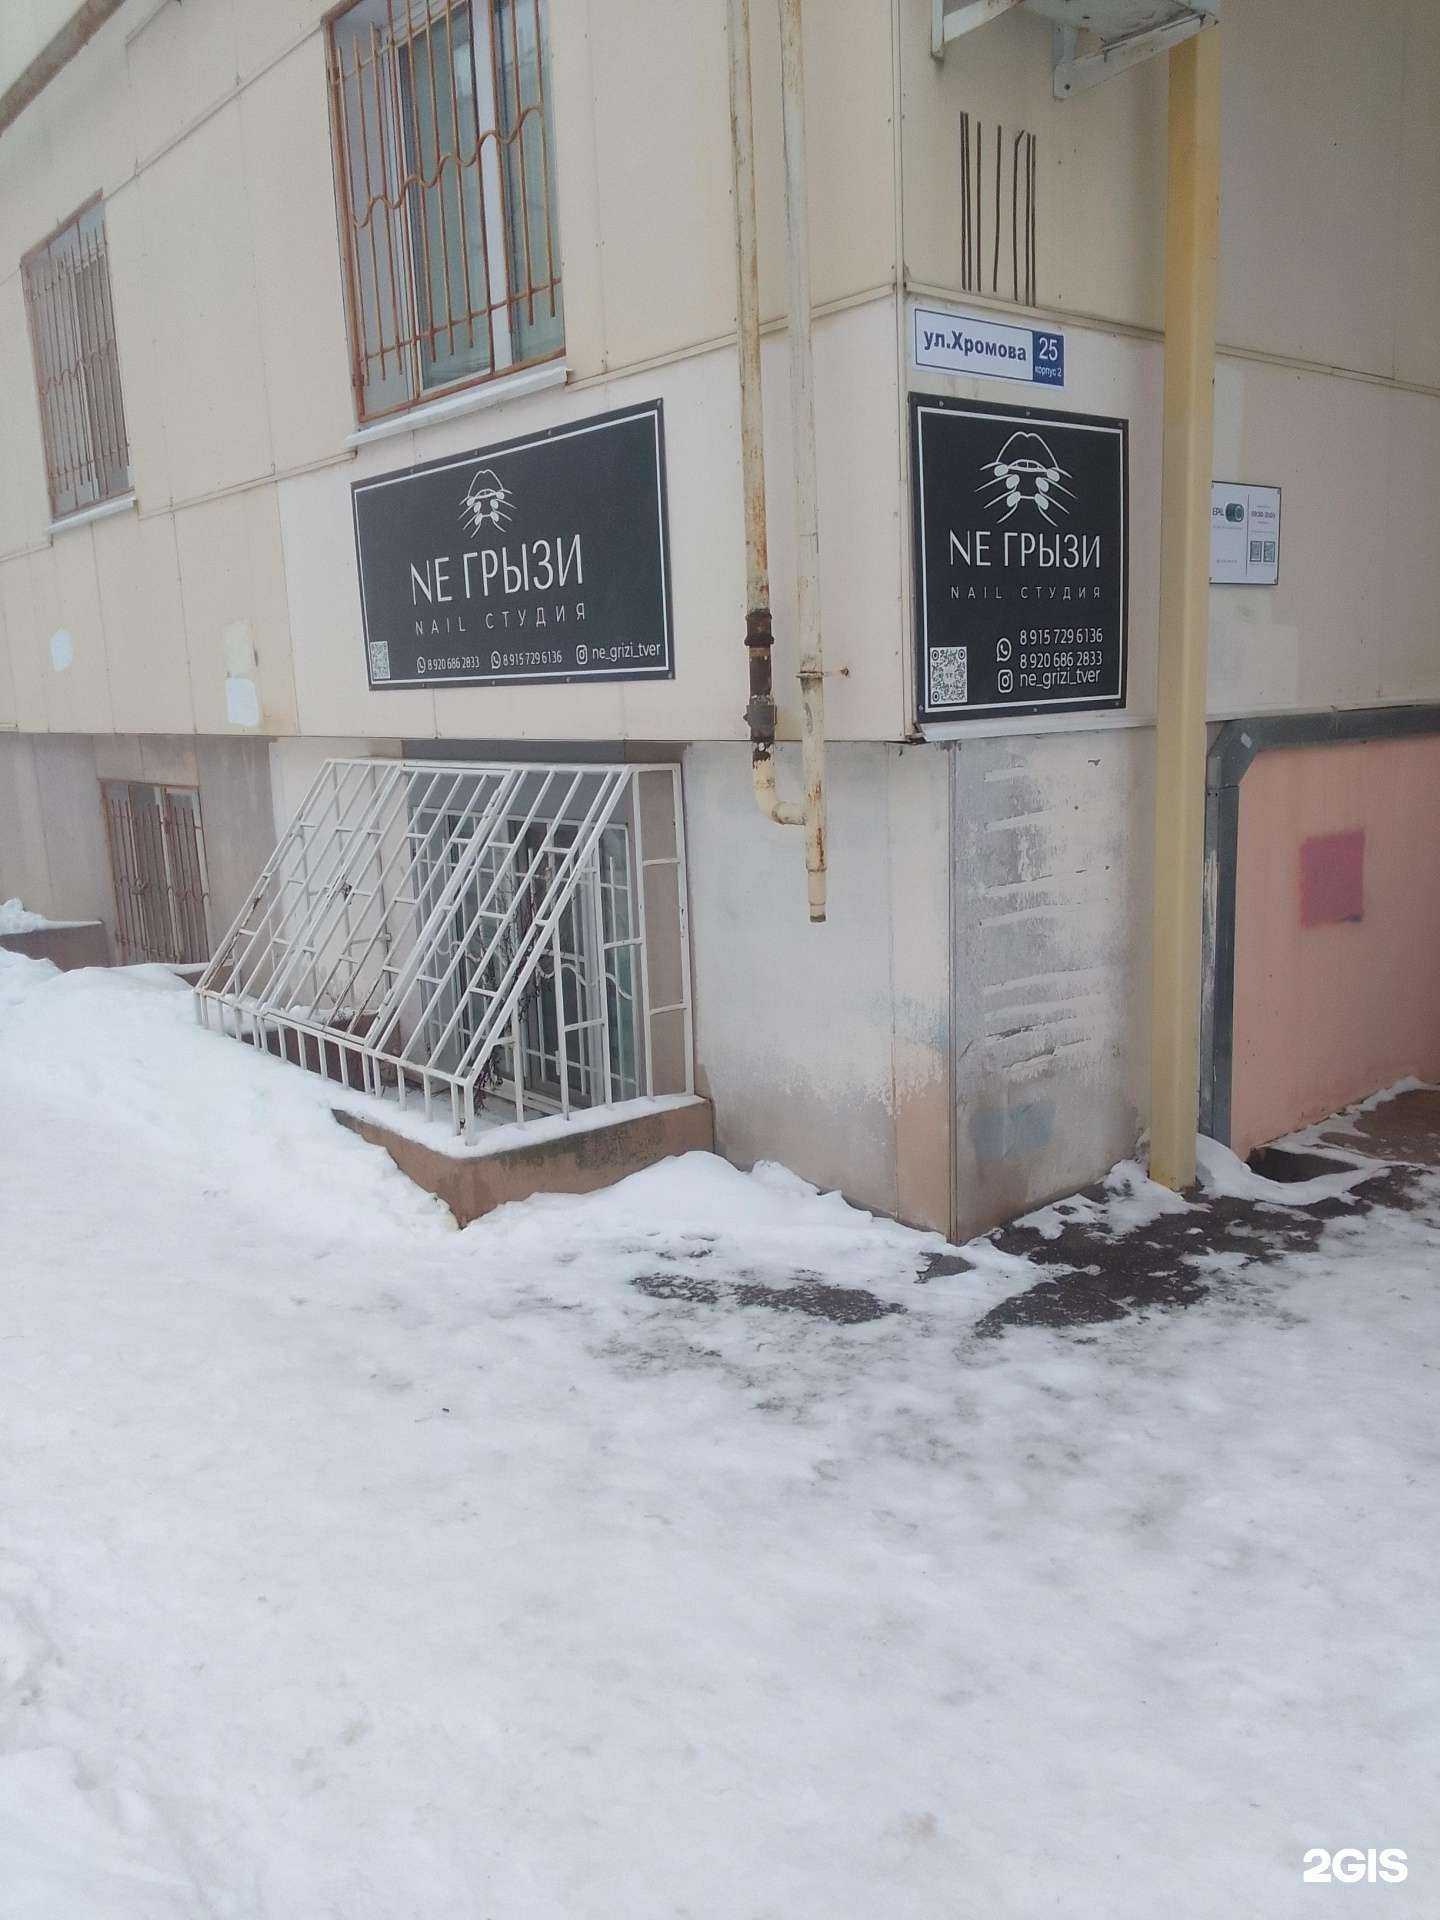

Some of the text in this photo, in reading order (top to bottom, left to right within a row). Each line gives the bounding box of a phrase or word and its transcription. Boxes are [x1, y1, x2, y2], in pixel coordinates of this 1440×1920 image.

[923, 330, 1059, 361] ул.Хромова 25
[1034, 365, 1062, 377] корпус 2
[949, 530, 1100, 568] NE ГРЫЗИ
[410, 534, 583, 606] NE ГРЫЗИ
[951, 586, 1100, 600] NAIL СТУДИЯ
[415, 602, 585, 635] NAIL СТУДИЯ
[1020, 627, 1103, 645] 8 915 729 6136
[592, 641, 661, 662] ne_grizi_tver
[1020, 650, 1103, 669] 8 920 686 2833
[1020, 667, 1101, 689] ne_grizi_tver
